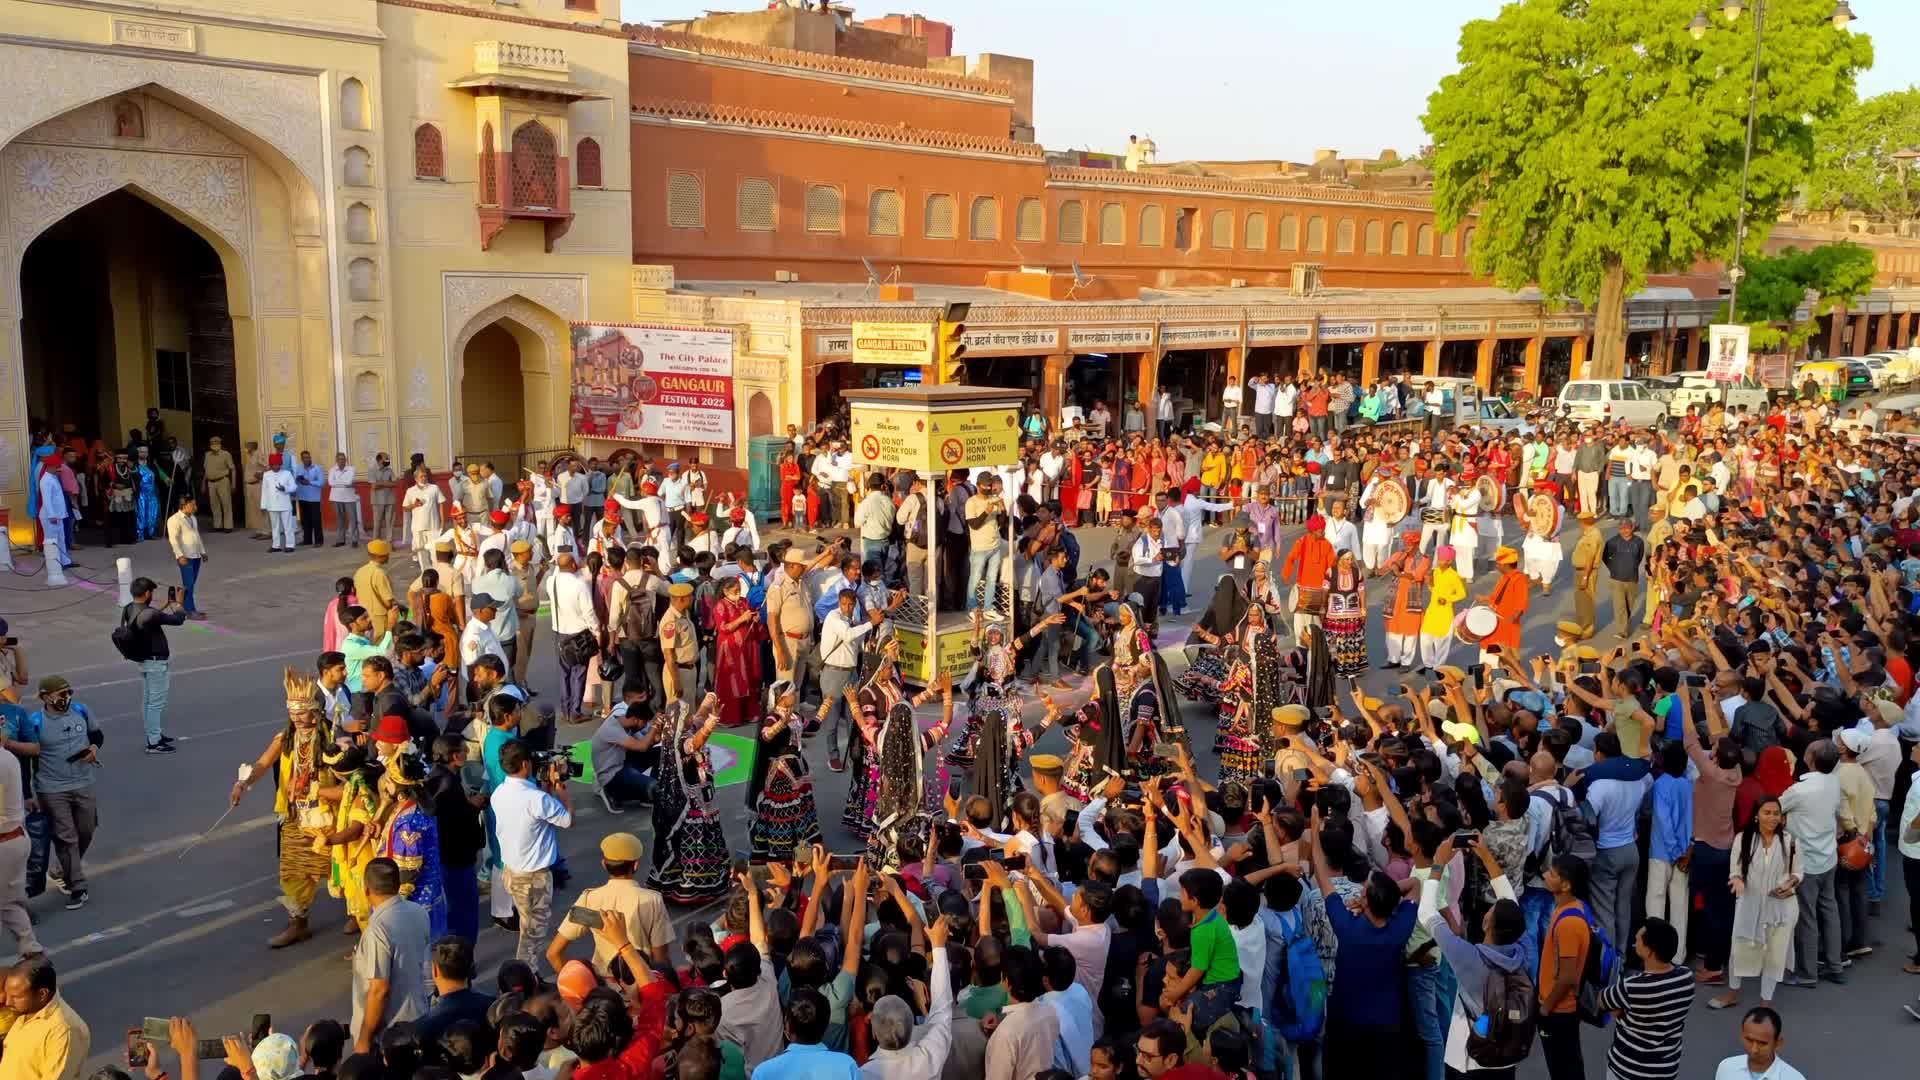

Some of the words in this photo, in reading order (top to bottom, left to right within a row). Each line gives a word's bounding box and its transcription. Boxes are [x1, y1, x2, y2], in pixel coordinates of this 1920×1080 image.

[858, 339, 892, 350] GANGAUR
[894, 340, 925, 351] FESTIVAL
[660, 353, 675, 361] The
[678, 354, 695, 363] City
[699, 355, 728, 364] Palace
[661, 377, 725, 393] GANGAUR
[660, 395, 699, 405] FESTIVAL
[701, 397, 725, 407] 2022
[882, 437, 890, 445] DO
[891, 438, 904, 446] NOT
[966, 438, 976, 446] DO
[977, 436, 992, 445] NOT
[882, 446, 899, 454] HONK
[900, 447, 918, 456] YOUR
[966, 445, 986, 454] HONK
[987, 444, 1007, 453] YOUR
[882, 454, 900, 463] HORN
[966, 454, 986, 463] HORN
